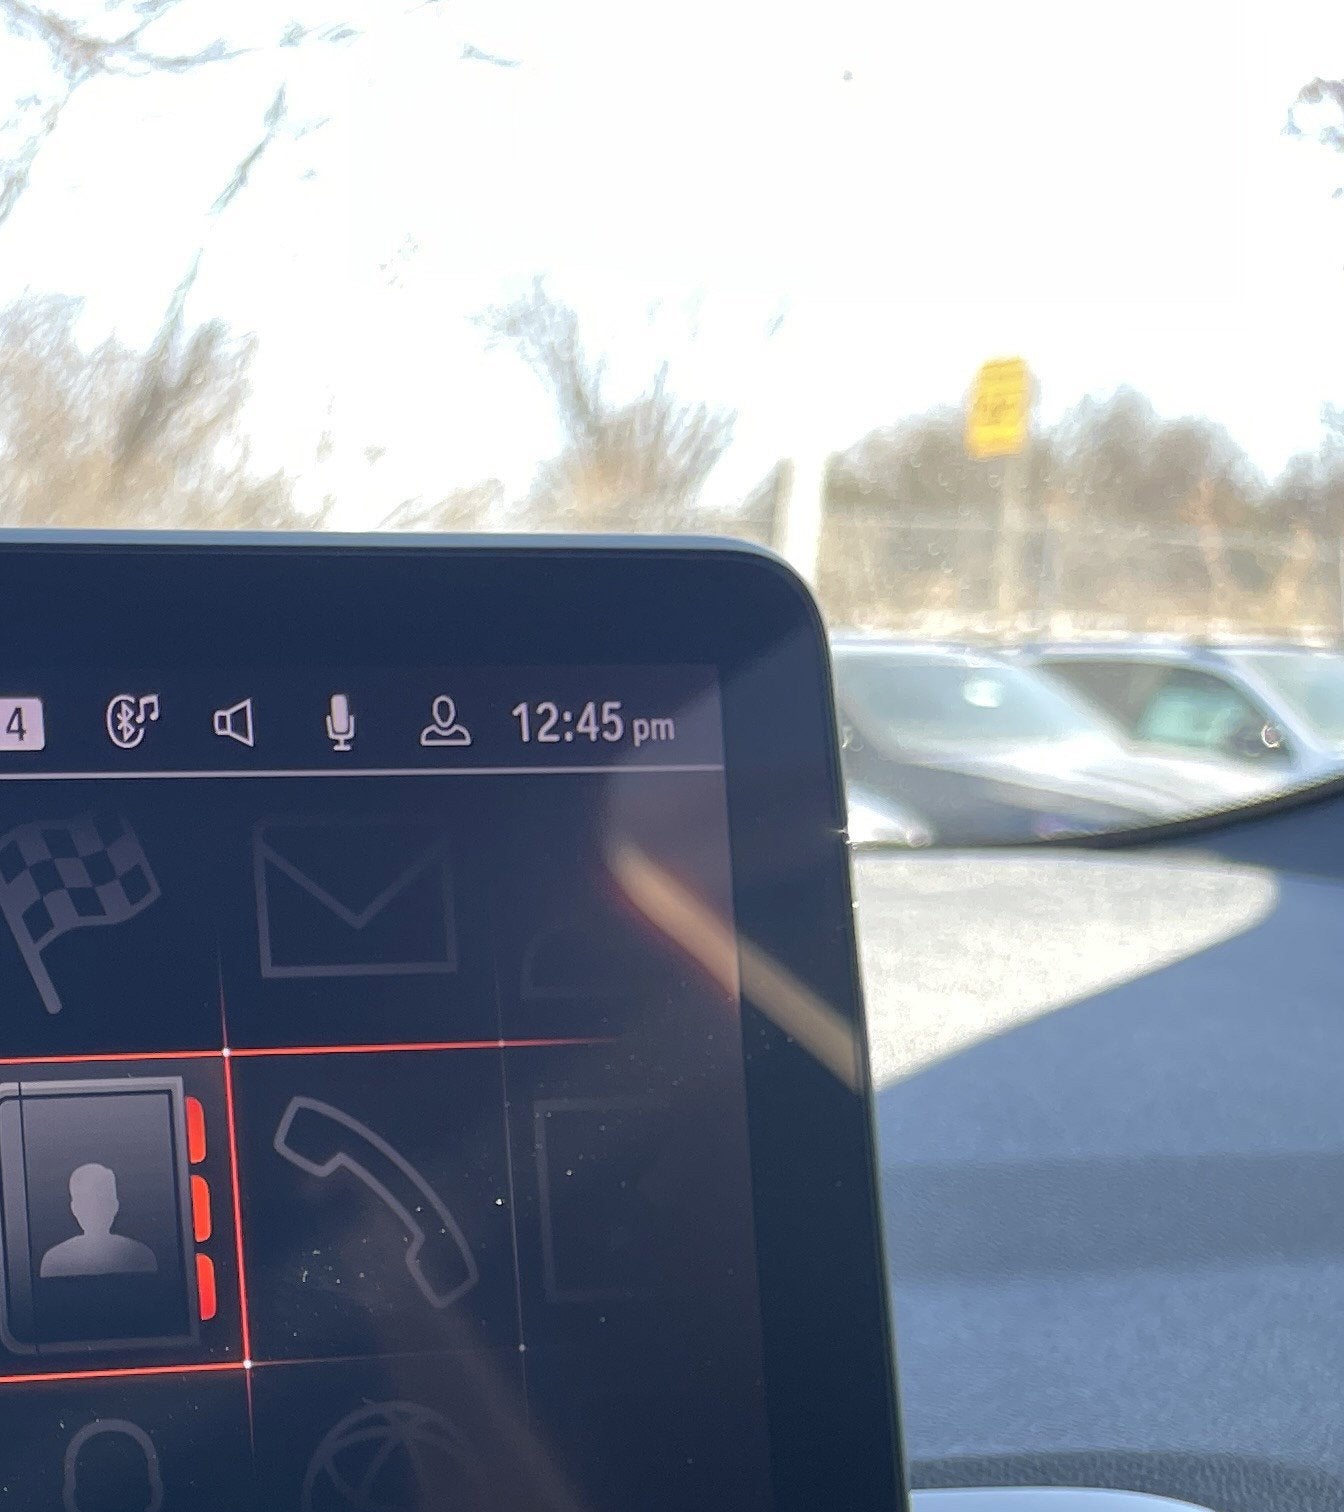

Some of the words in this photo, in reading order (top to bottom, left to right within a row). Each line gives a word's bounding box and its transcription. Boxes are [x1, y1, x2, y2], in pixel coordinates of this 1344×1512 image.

[5, 706, 27, 741] 4
[512, 701, 624, 742] 12:45
[633, 717, 675, 747] pm
